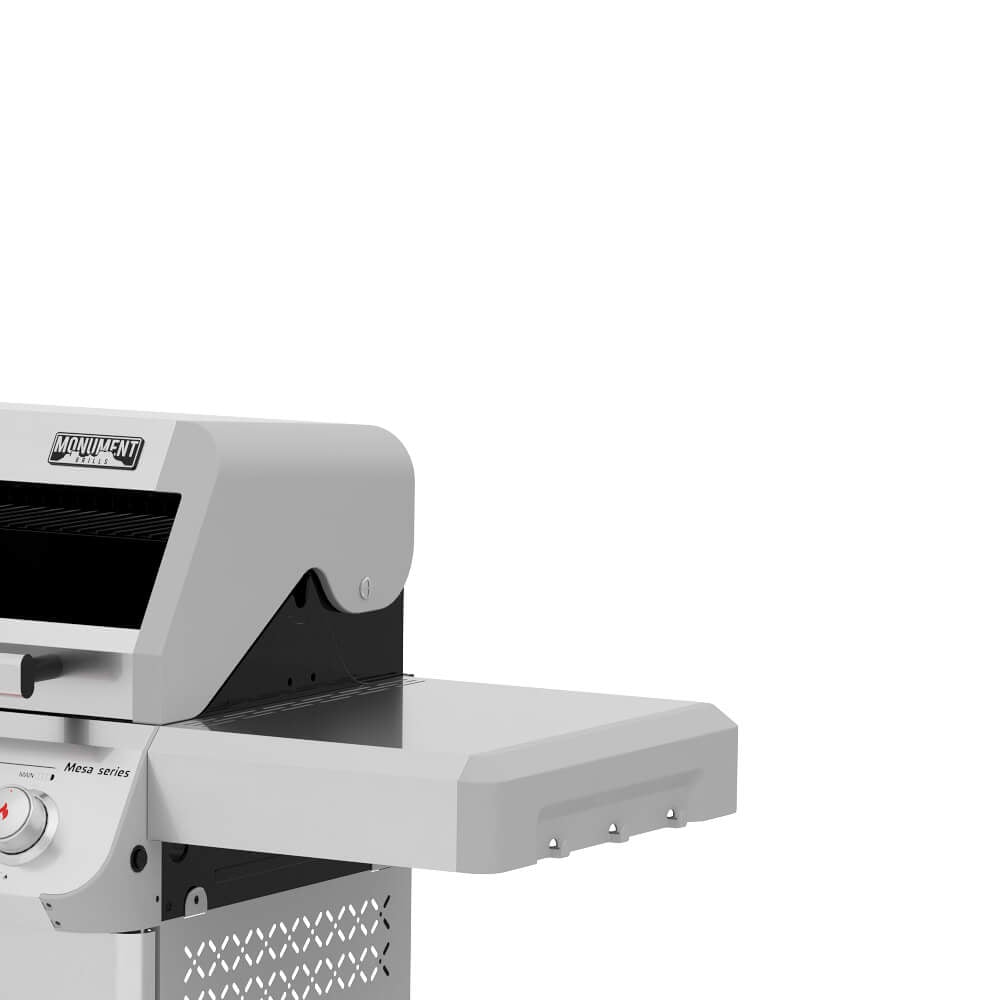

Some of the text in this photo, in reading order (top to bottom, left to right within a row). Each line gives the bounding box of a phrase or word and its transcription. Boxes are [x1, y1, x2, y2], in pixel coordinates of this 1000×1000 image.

[53, 435, 139, 458] MONUMENT
[63, 761, 131, 778] Mesa series
